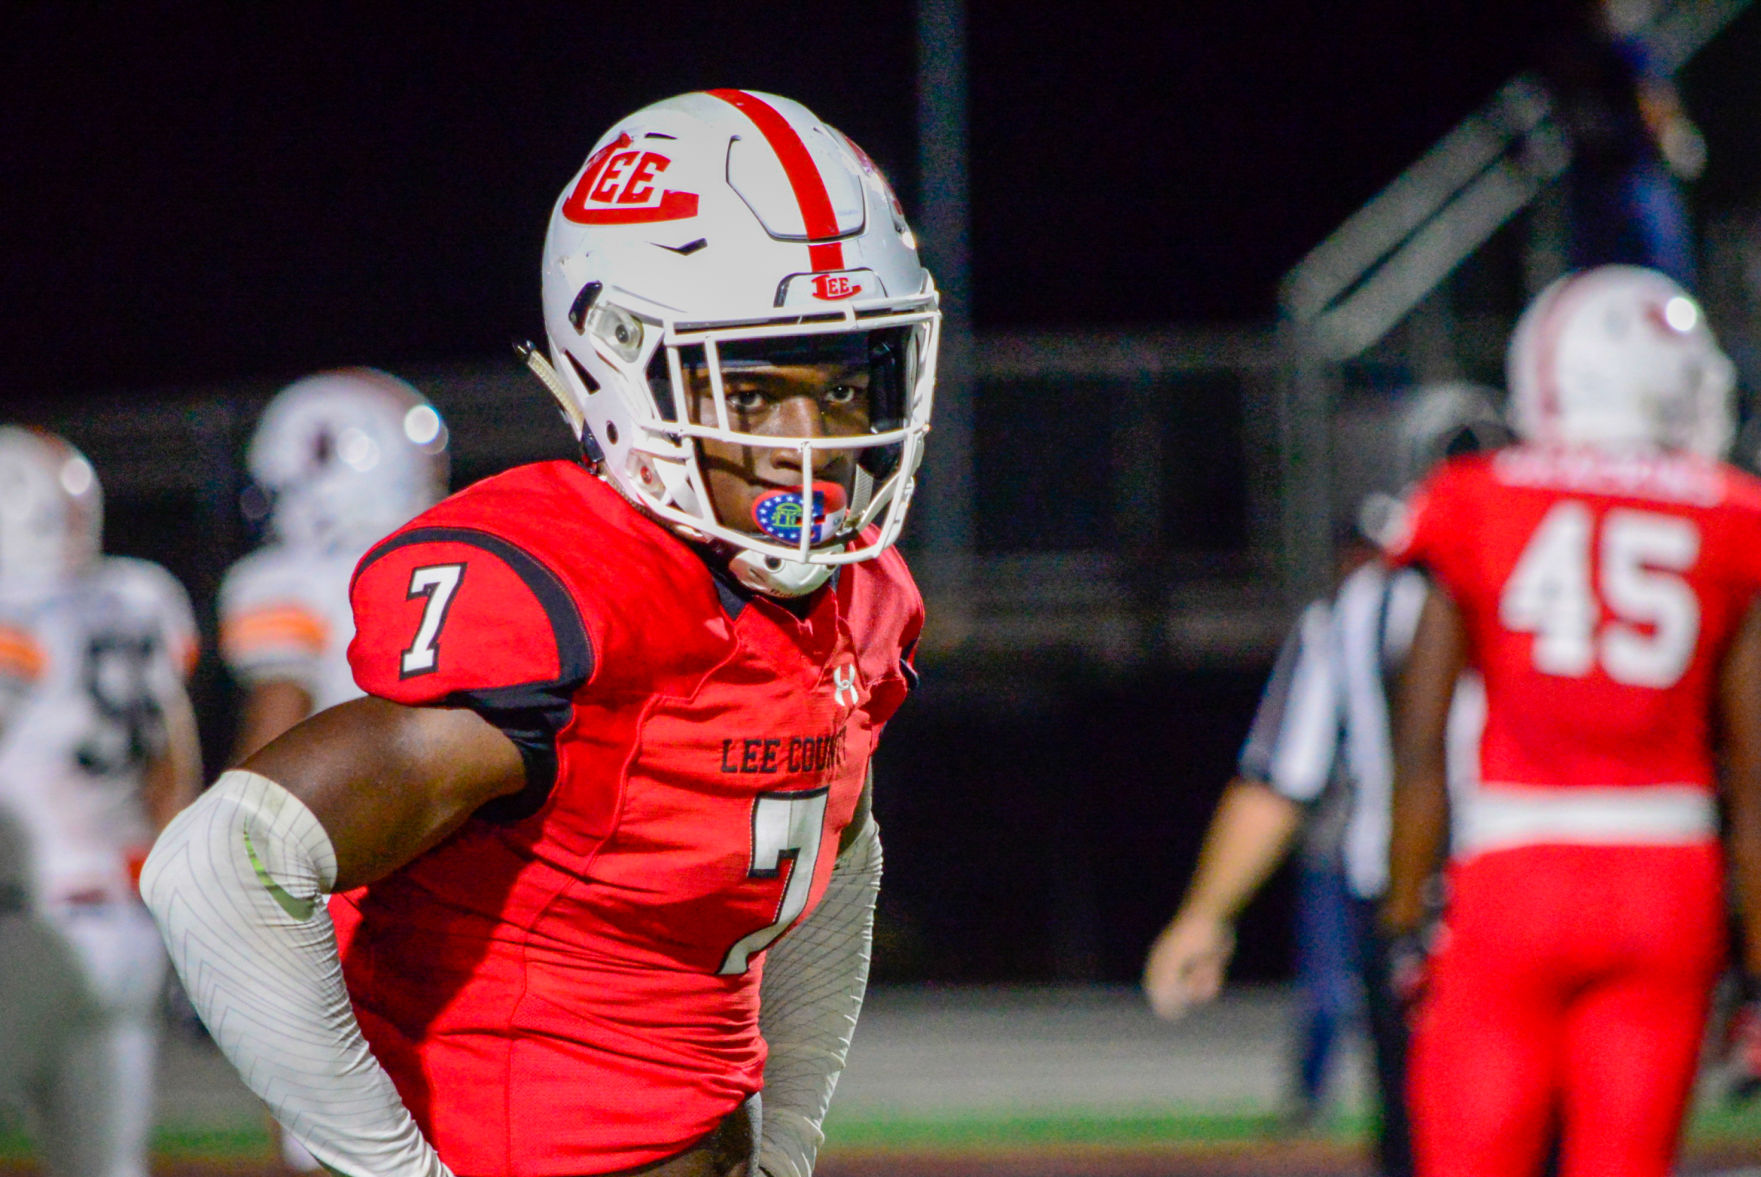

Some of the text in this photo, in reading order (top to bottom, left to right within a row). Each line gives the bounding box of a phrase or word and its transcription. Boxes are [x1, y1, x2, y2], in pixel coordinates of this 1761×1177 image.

[562, 131, 699, 225] LEE
[811, 274, 863, 300] LEE
[399, 562, 468, 681] 7
[1499, 498, 1702, 690] 45
[720, 738, 781, 773] LEE
[716, 785, 831, 976] 7
